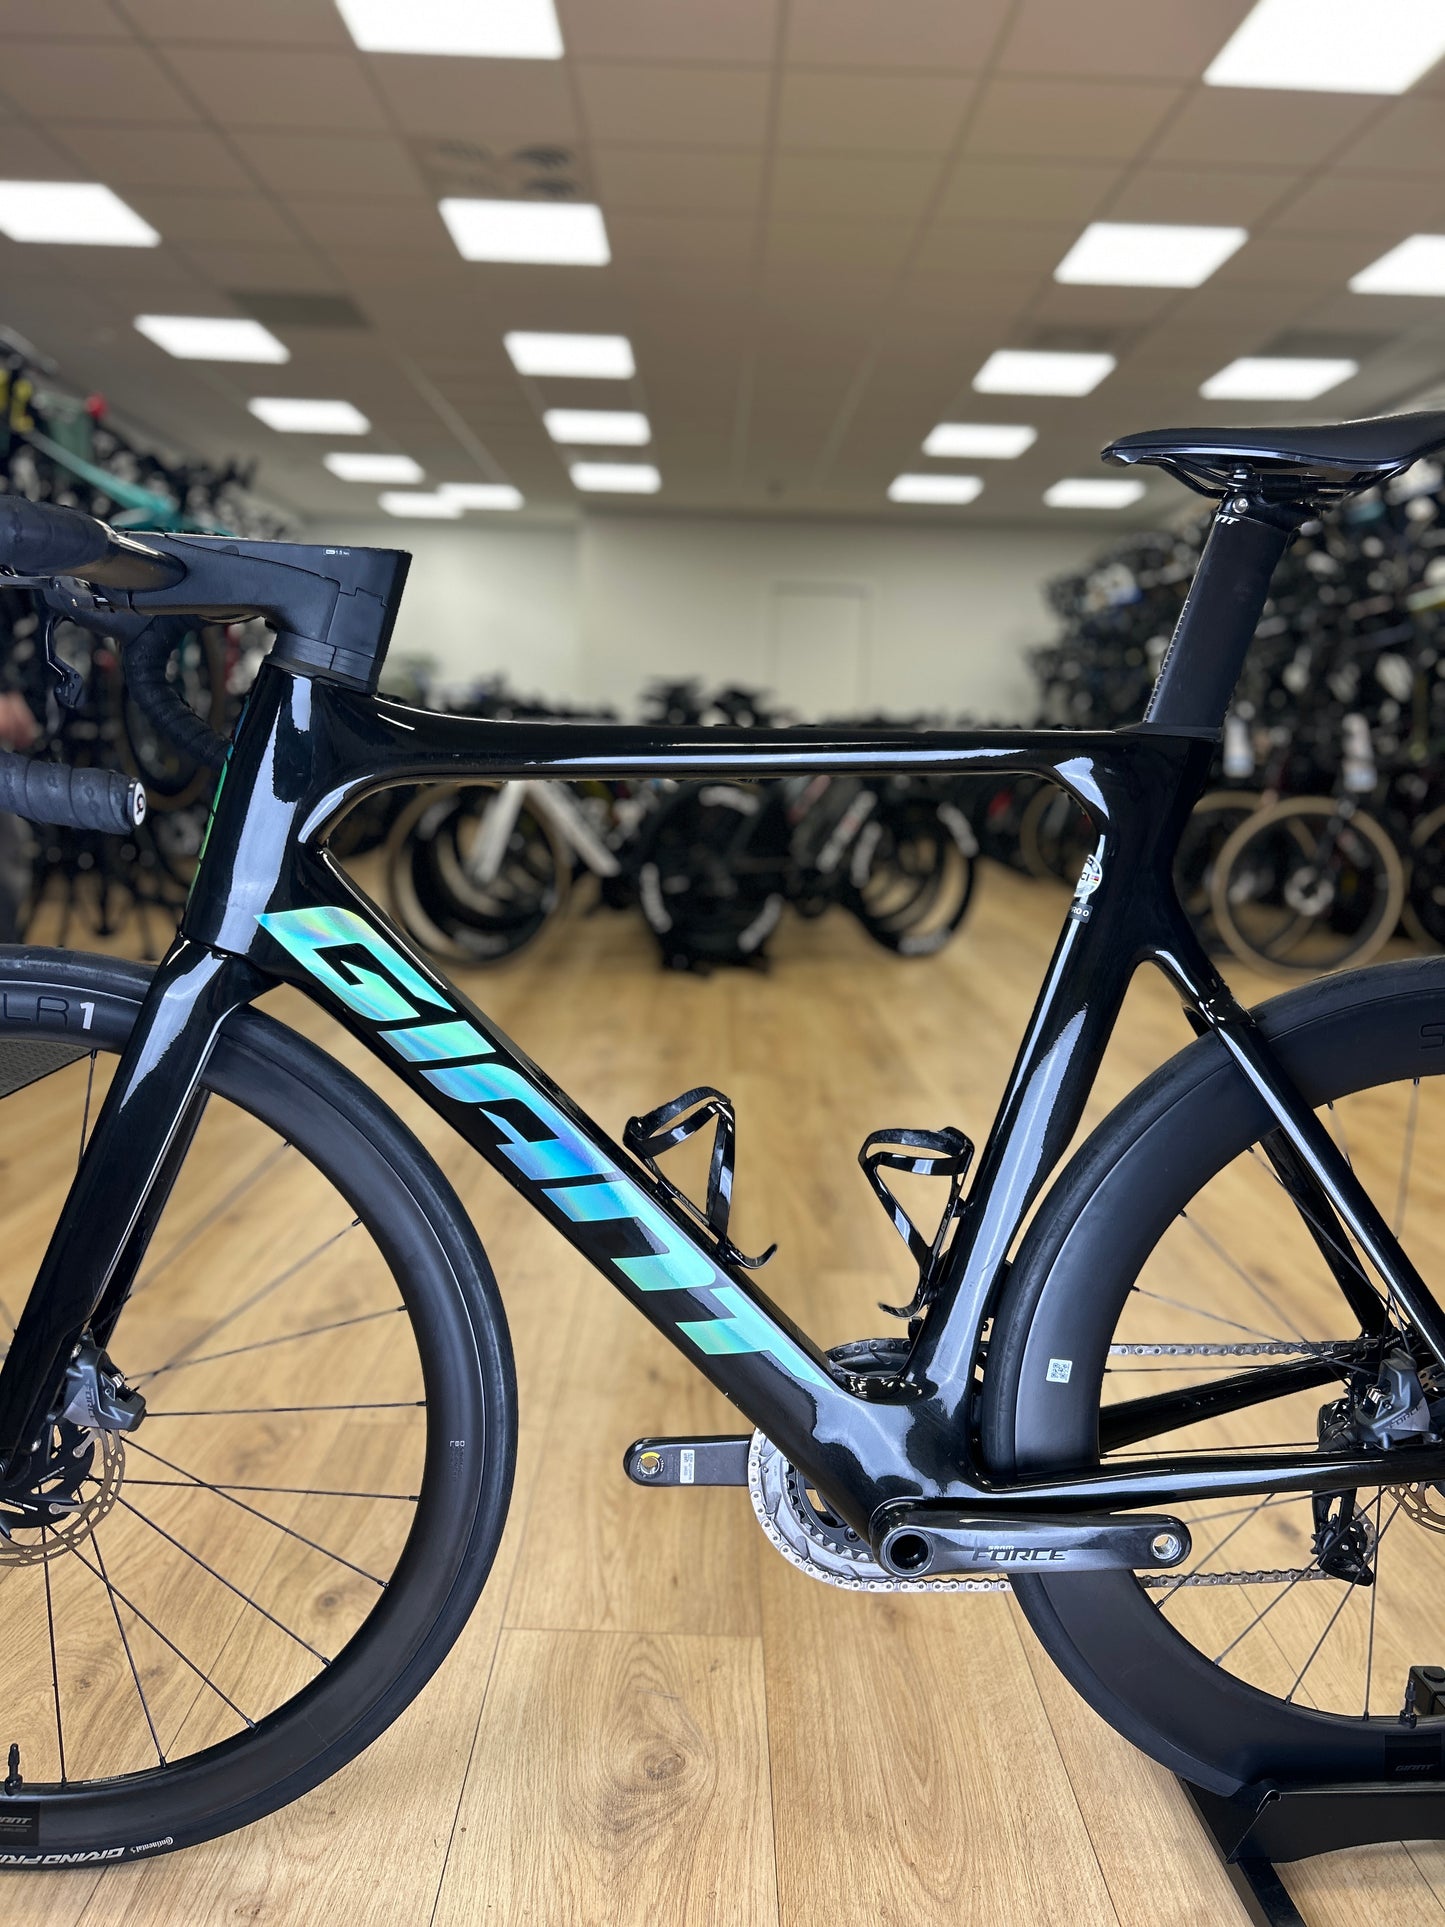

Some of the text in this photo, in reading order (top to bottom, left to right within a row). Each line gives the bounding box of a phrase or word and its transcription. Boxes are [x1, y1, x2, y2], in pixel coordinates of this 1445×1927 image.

[79, 1001, 95, 1030] 1
[253, 906, 836, 1392] GIANT
[971, 1547, 1068, 1561] FORCE
[0, 1816, 33, 1824] ANT
[0, 1836, 174, 1865] Continental GRAND PRI
